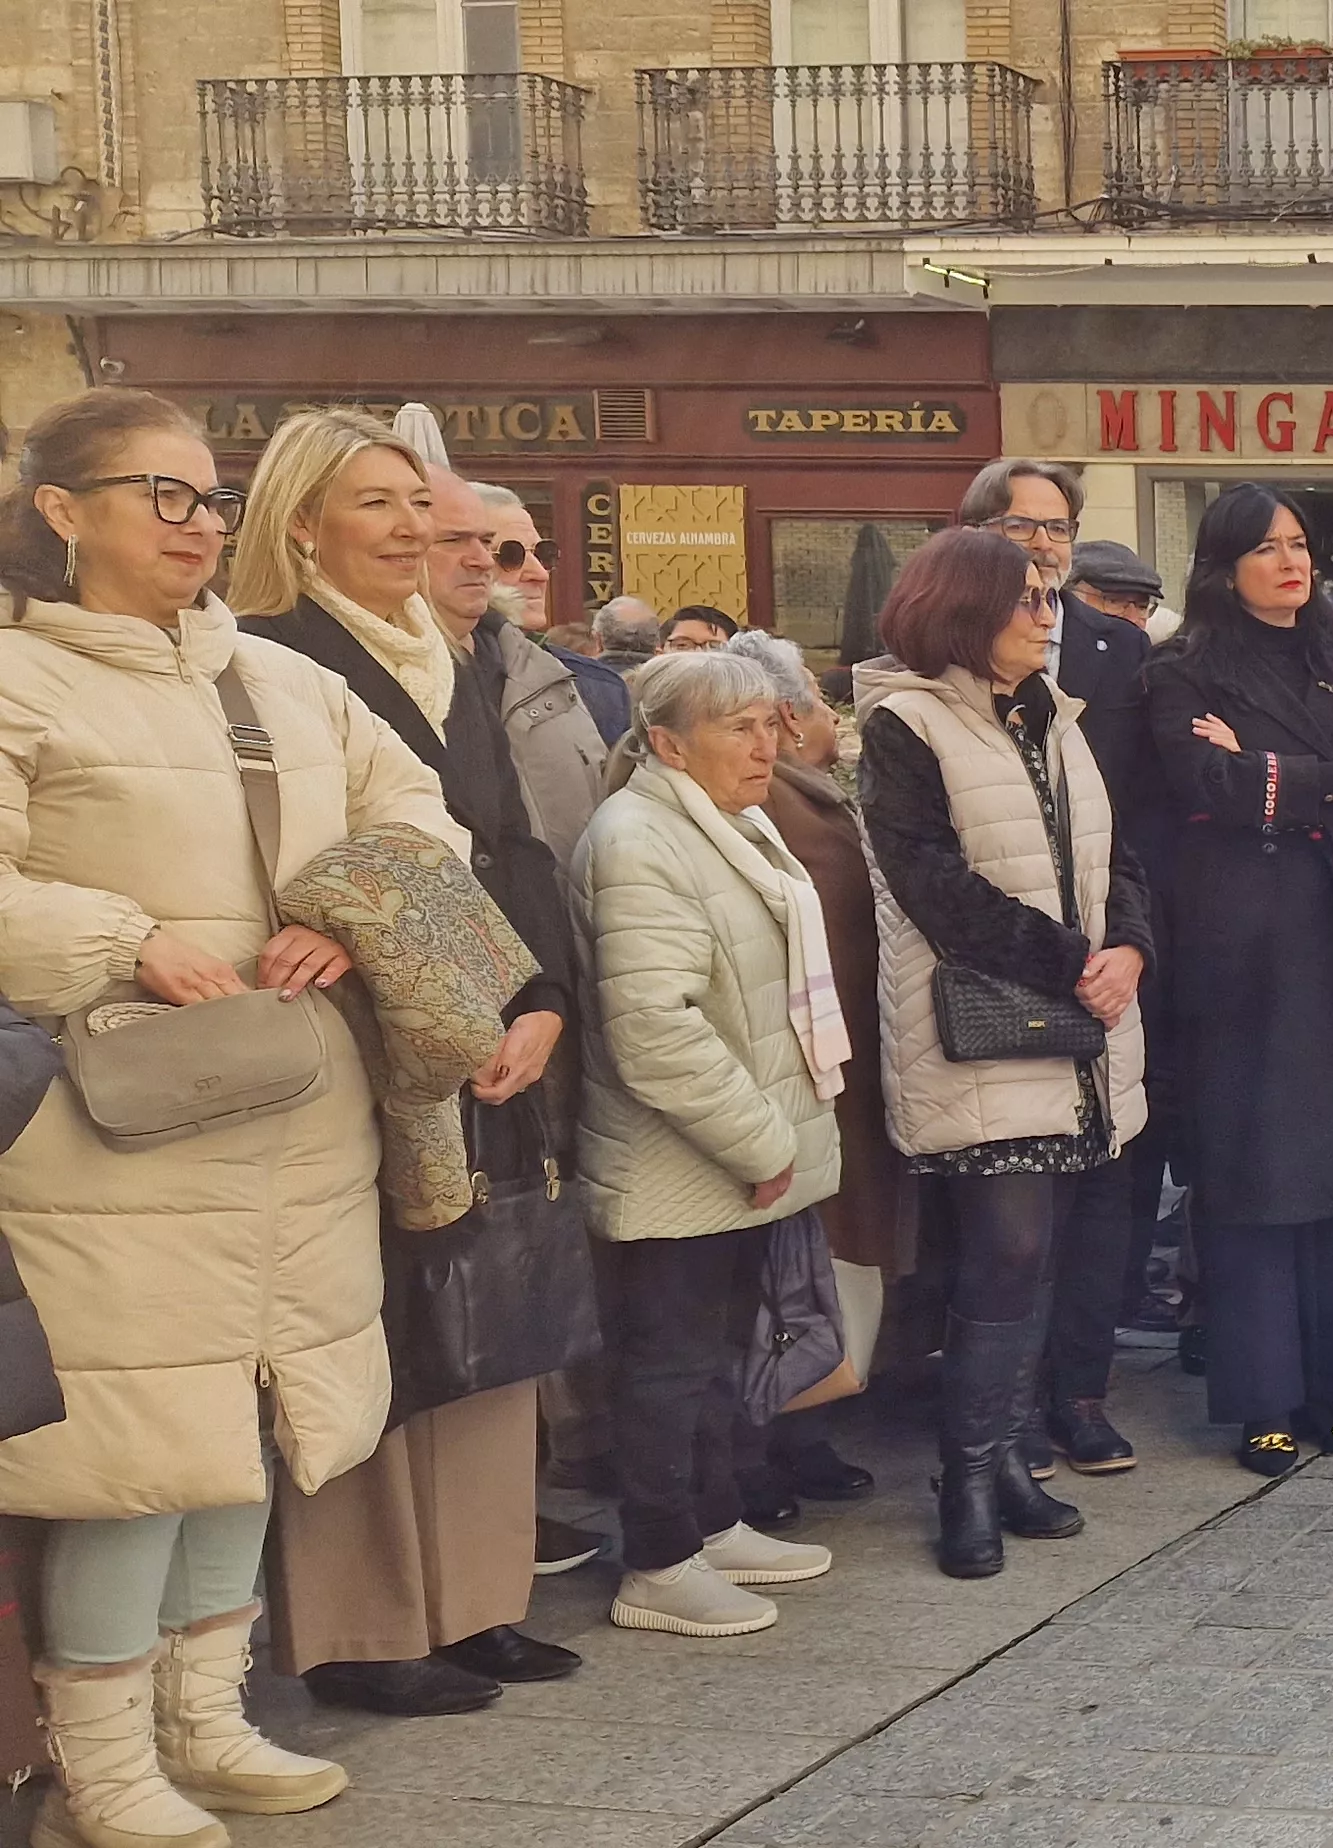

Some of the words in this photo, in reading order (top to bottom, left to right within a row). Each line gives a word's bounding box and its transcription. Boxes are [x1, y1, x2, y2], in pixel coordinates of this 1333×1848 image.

[749, 401, 960, 433] TAPERÍA
[626, 531, 676, 545] CERVEZAS
[679, 531, 736, 545] ALHAMBRA
